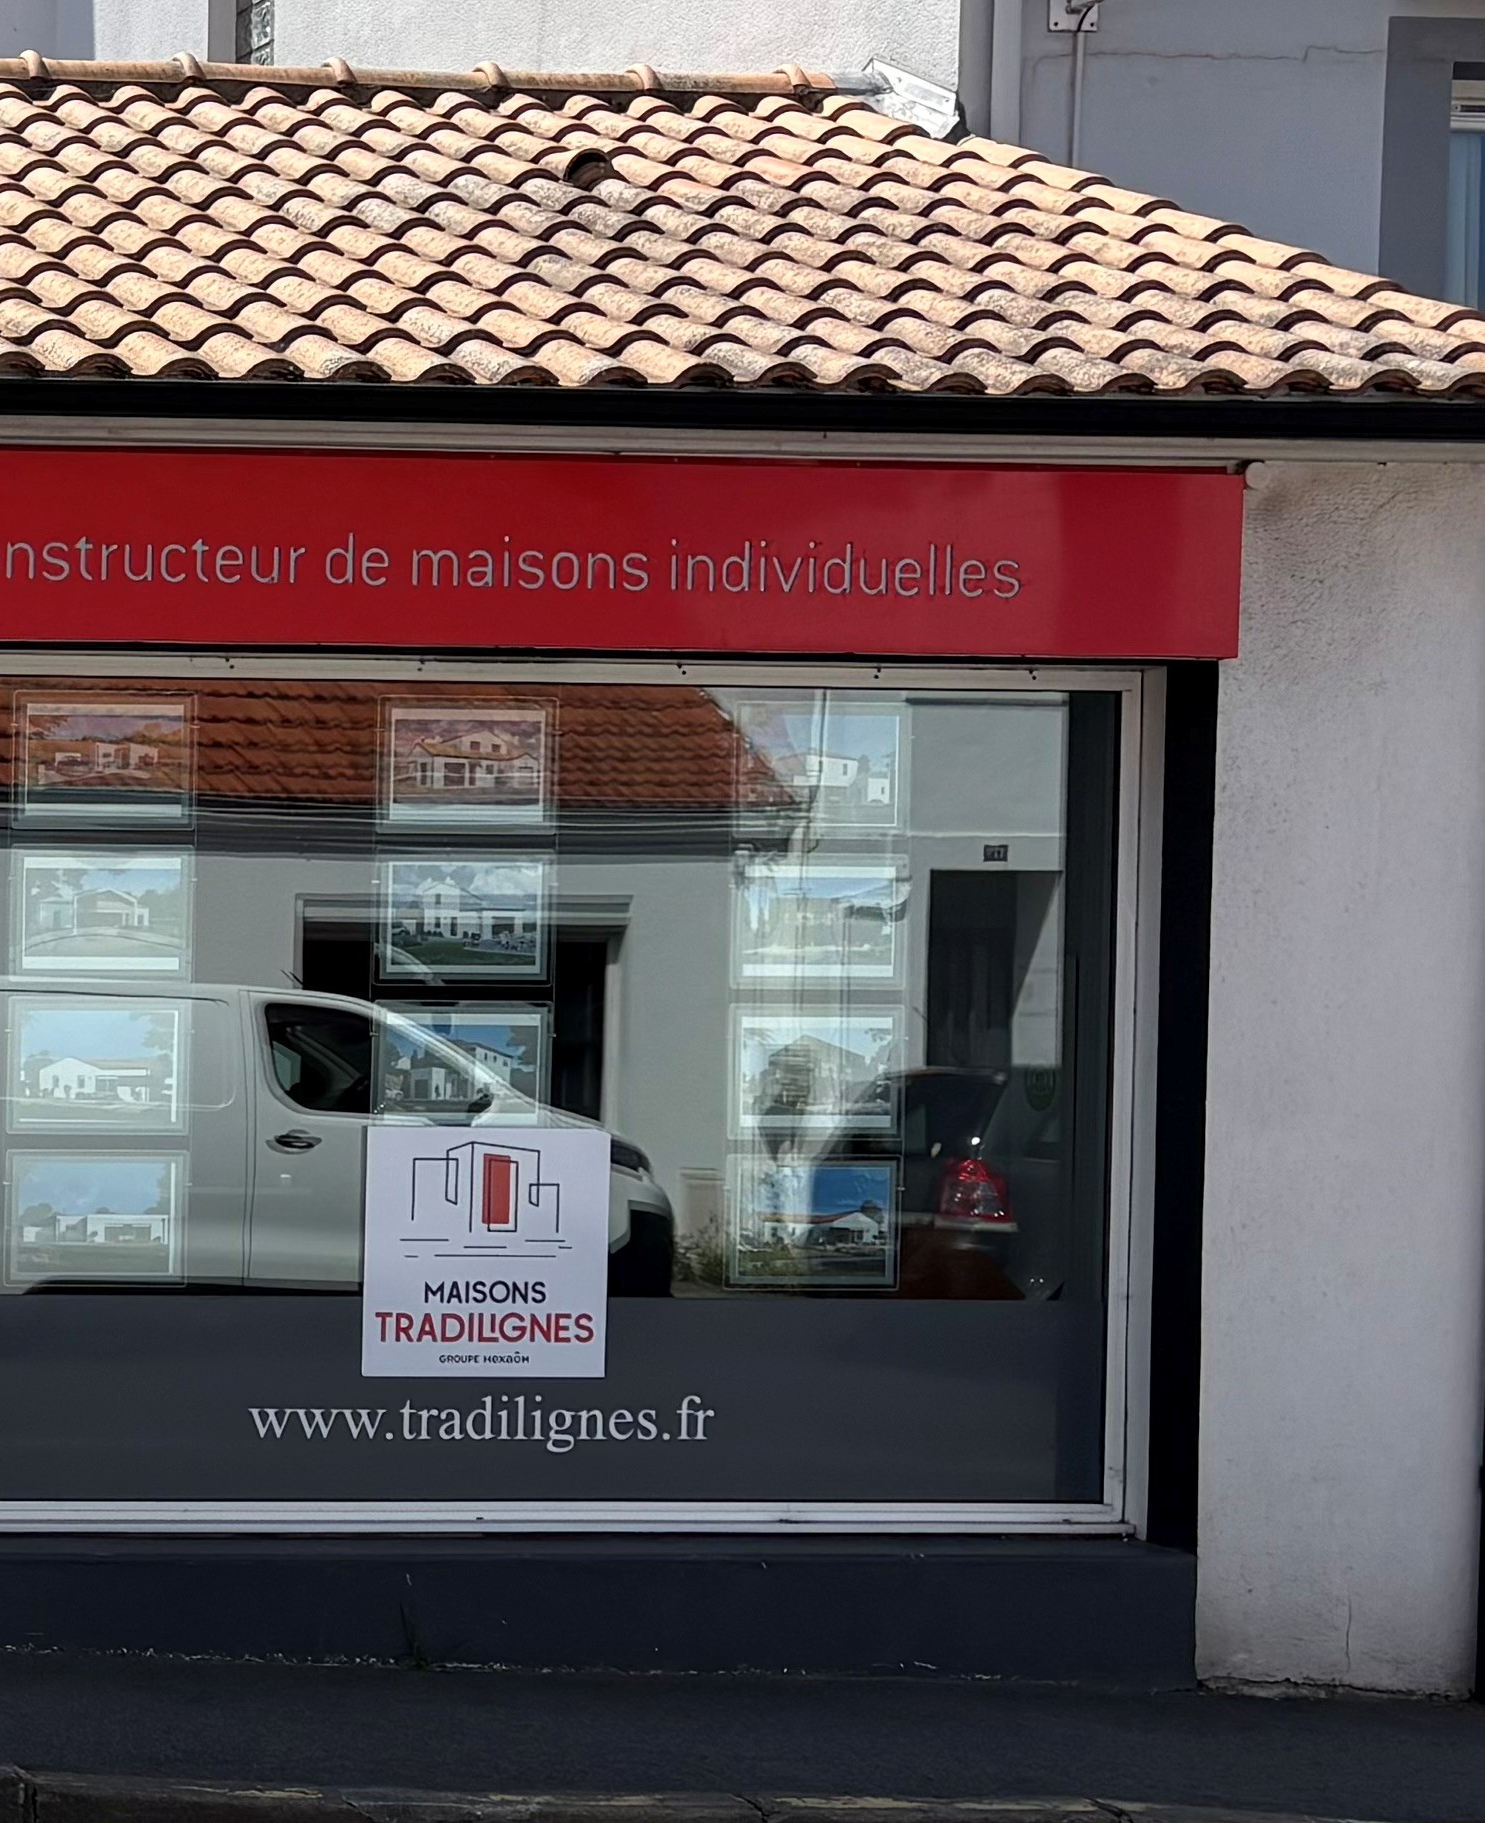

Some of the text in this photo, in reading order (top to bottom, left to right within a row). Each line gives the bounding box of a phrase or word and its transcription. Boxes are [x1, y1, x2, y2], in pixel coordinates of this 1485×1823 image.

[323, 532, 390, 587] de
[409, 536, 649, 592] maisons
[667, 539, 1022, 600] individuelles
[424, 1280, 547, 1304] MAISONS
[375, 1312, 594, 1343] TRADILIGNES
[438, 1354, 480, 1364] GROUPE
[247, 1395, 715, 1453] www.tradilignes.fr
